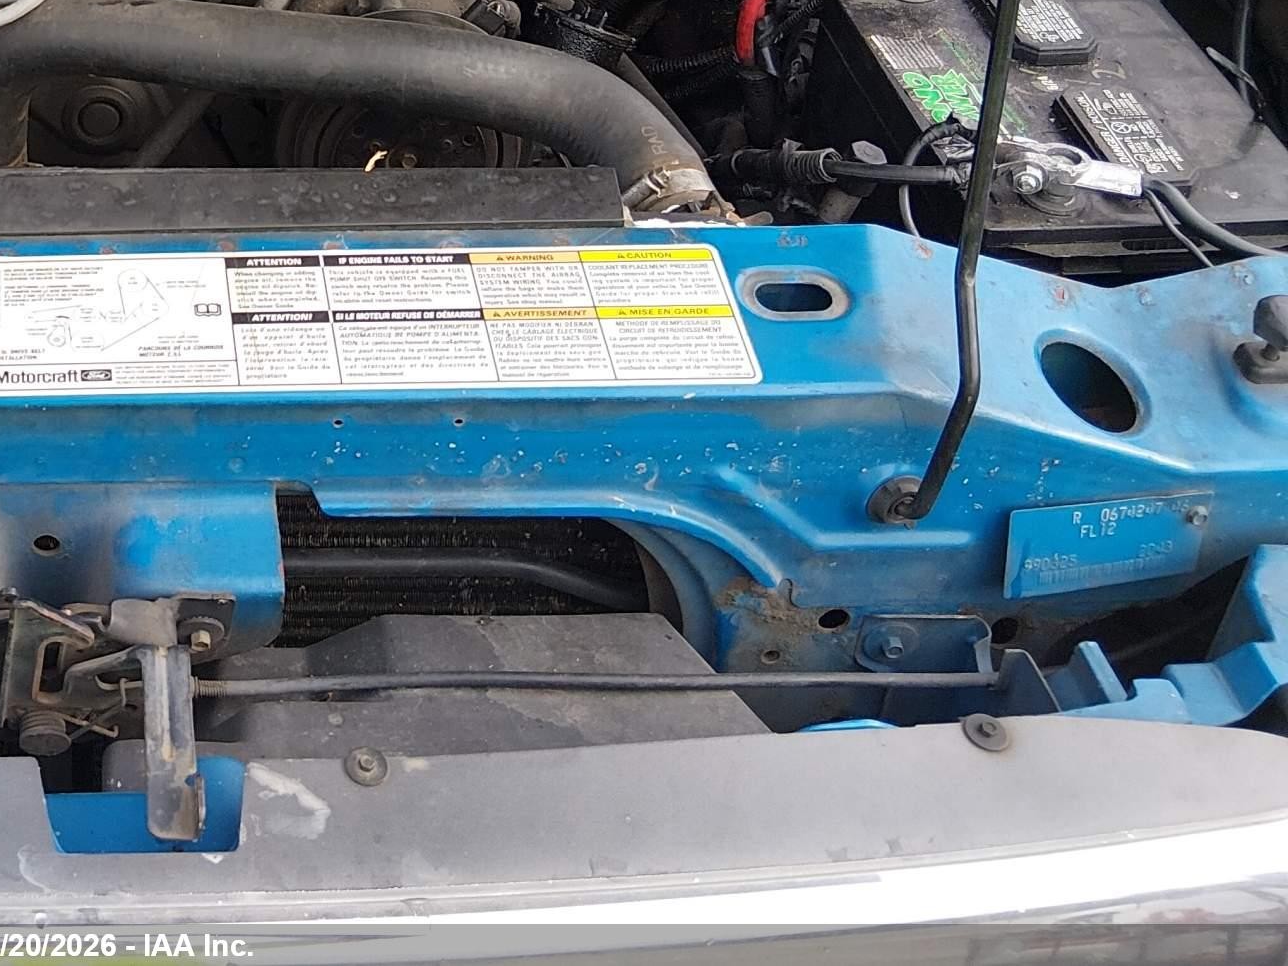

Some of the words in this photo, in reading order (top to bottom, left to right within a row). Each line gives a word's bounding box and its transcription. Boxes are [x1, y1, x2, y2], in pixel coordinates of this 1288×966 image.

[1074, 96, 1103, 124] POISON
[1100, 131, 1130, 164] DANGER
[245, 257, 302, 266] ATTENTION
[338, 257, 346, 265] IF
[348, 256, 382, 264] ENGINE
[383, 255, 408, 263] FAILS
[410, 255, 423, 263] TO
[424, 254, 453, 262] START
[344, 312, 354, 321] LE
[355, 311, 390, 320] MOTEUR
[390, 311, 421, 320] REFUSE
[422, 310, 434, 319] DE
[435, 309, 481, 319] DÉMARRER
[503, 309, 587, 317] AVERTISSEMENT
[1073, 512, 1082, 524] R
